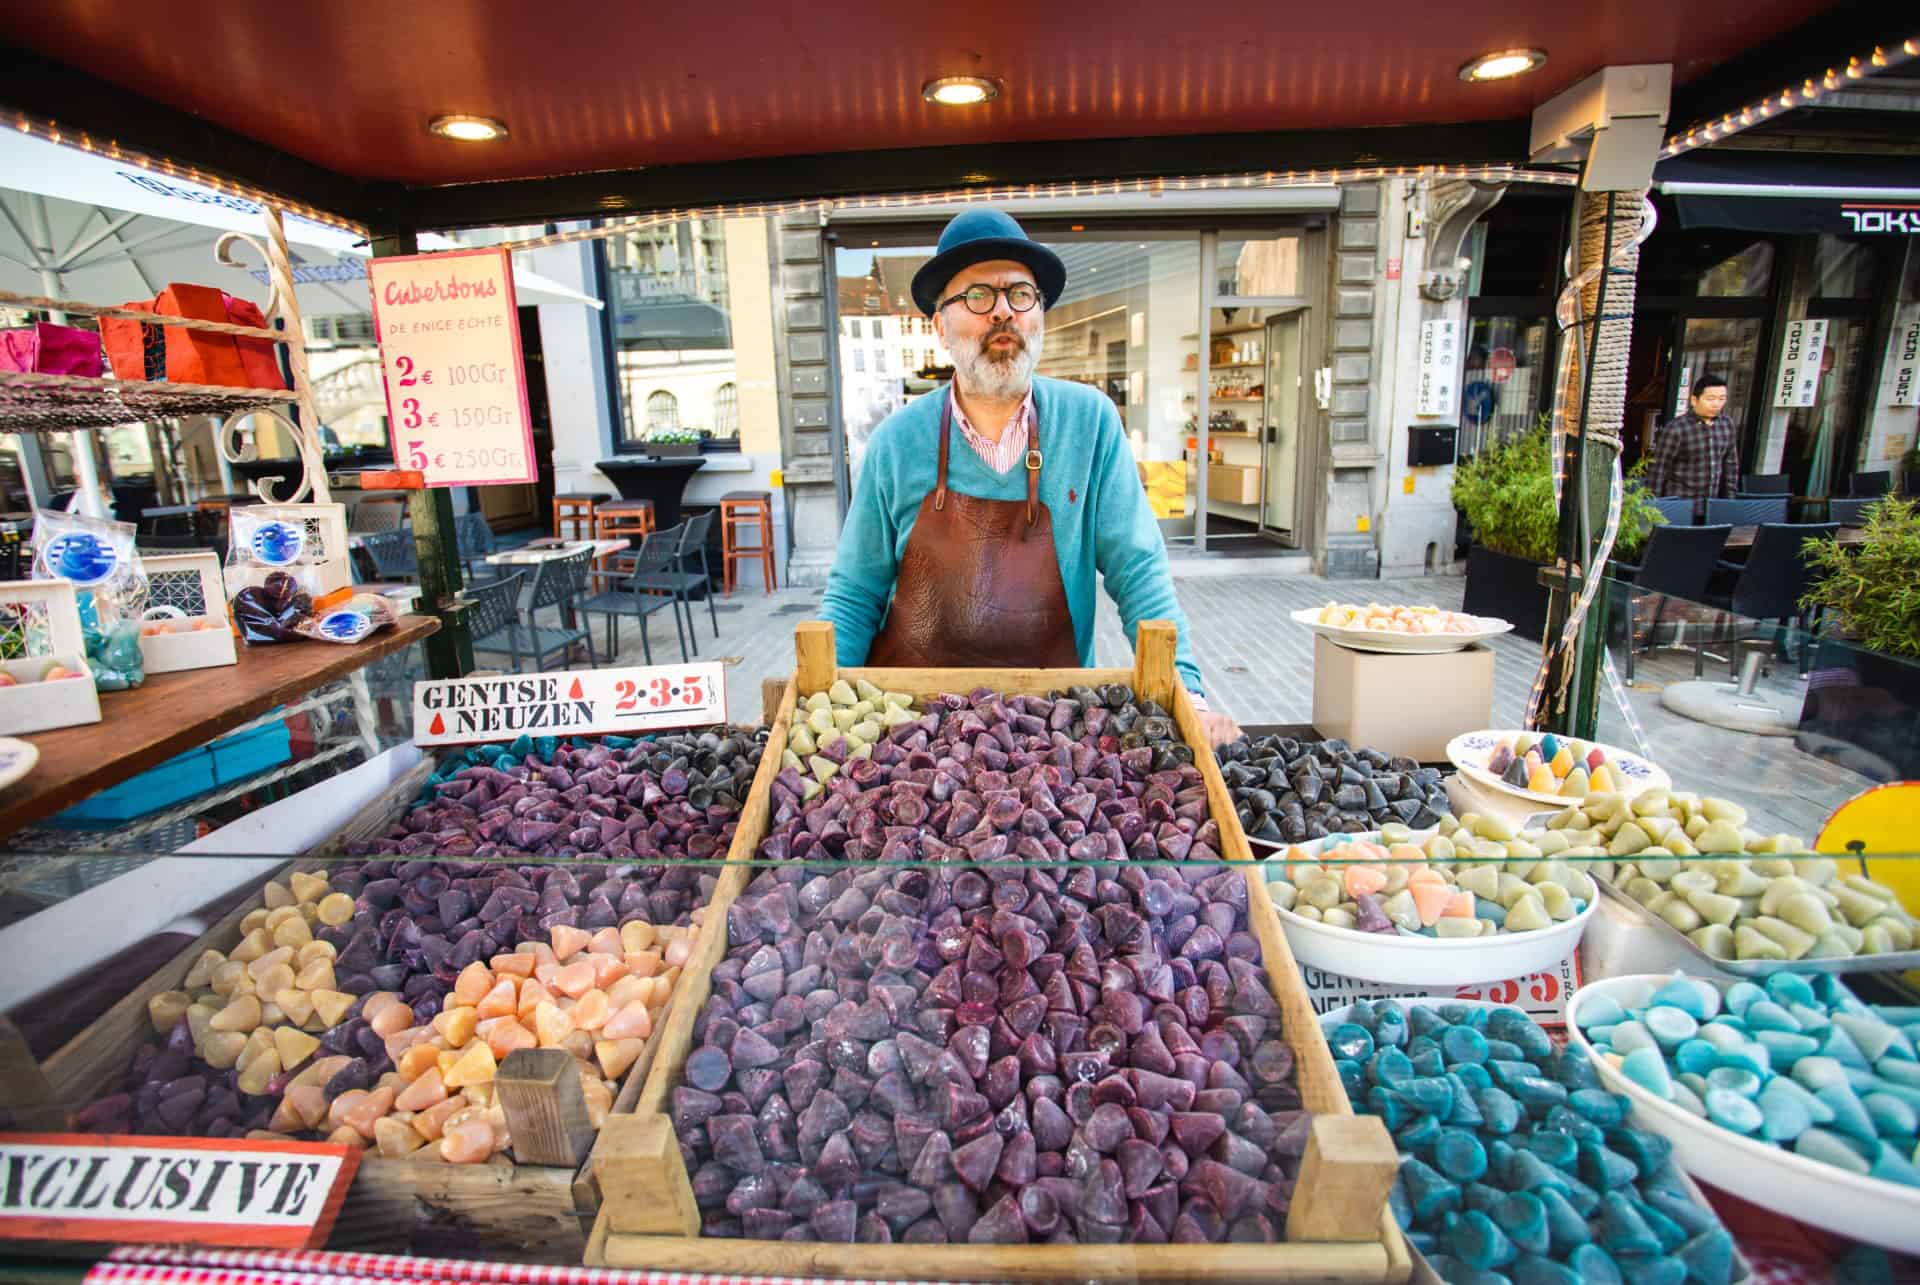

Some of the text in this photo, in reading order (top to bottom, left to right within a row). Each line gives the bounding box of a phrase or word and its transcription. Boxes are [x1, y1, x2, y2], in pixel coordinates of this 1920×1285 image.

[422, 677, 557, 709] GENTSE
[455, 699, 597, 734] NEUZEN
[0, 1153, 321, 1217] XCLUSIVE
